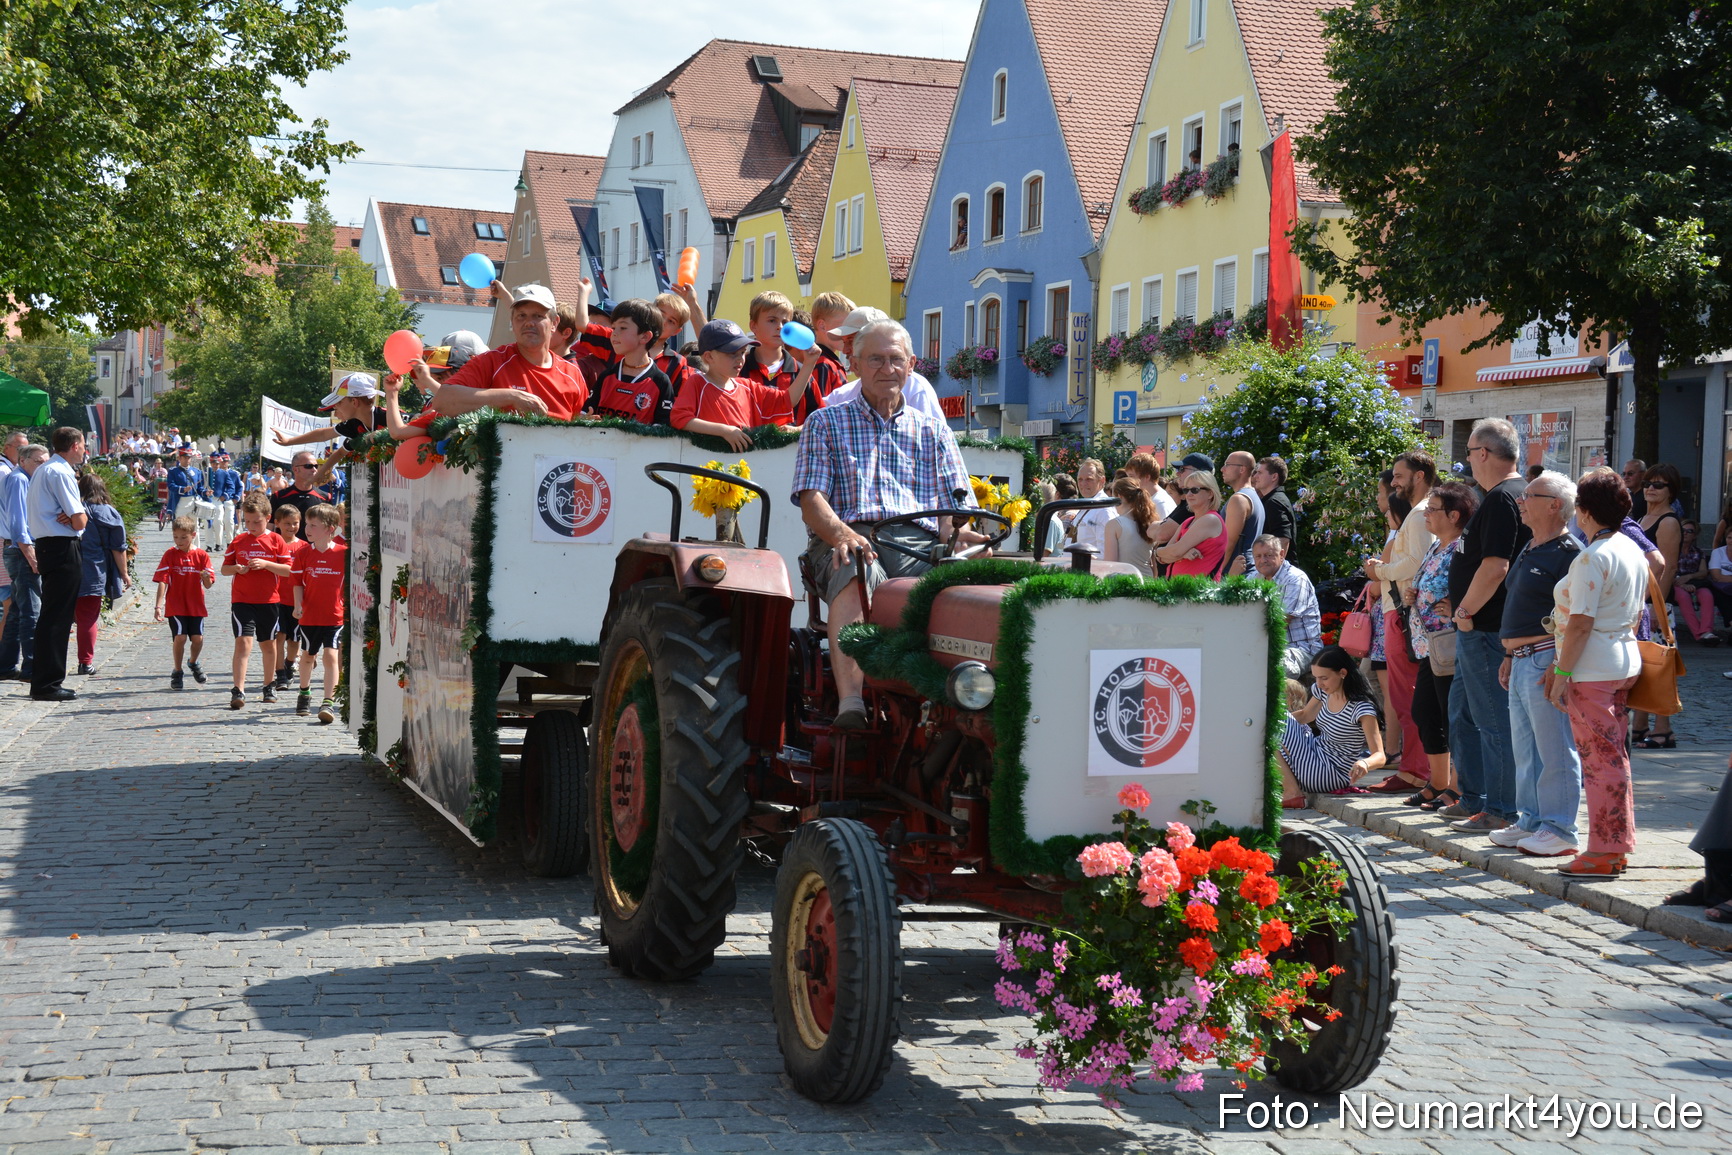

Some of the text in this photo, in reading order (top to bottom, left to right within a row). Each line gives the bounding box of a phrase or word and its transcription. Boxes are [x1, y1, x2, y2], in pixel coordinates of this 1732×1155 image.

[1073, 330, 1086, 397] WITTL
[1426, 345, 1435, 378] P
[1119, 395, 1132, 420] P
[542, 463, 608, 490] HOLZHEIM
[1100, 659, 1190, 698] HOLZHEIM
